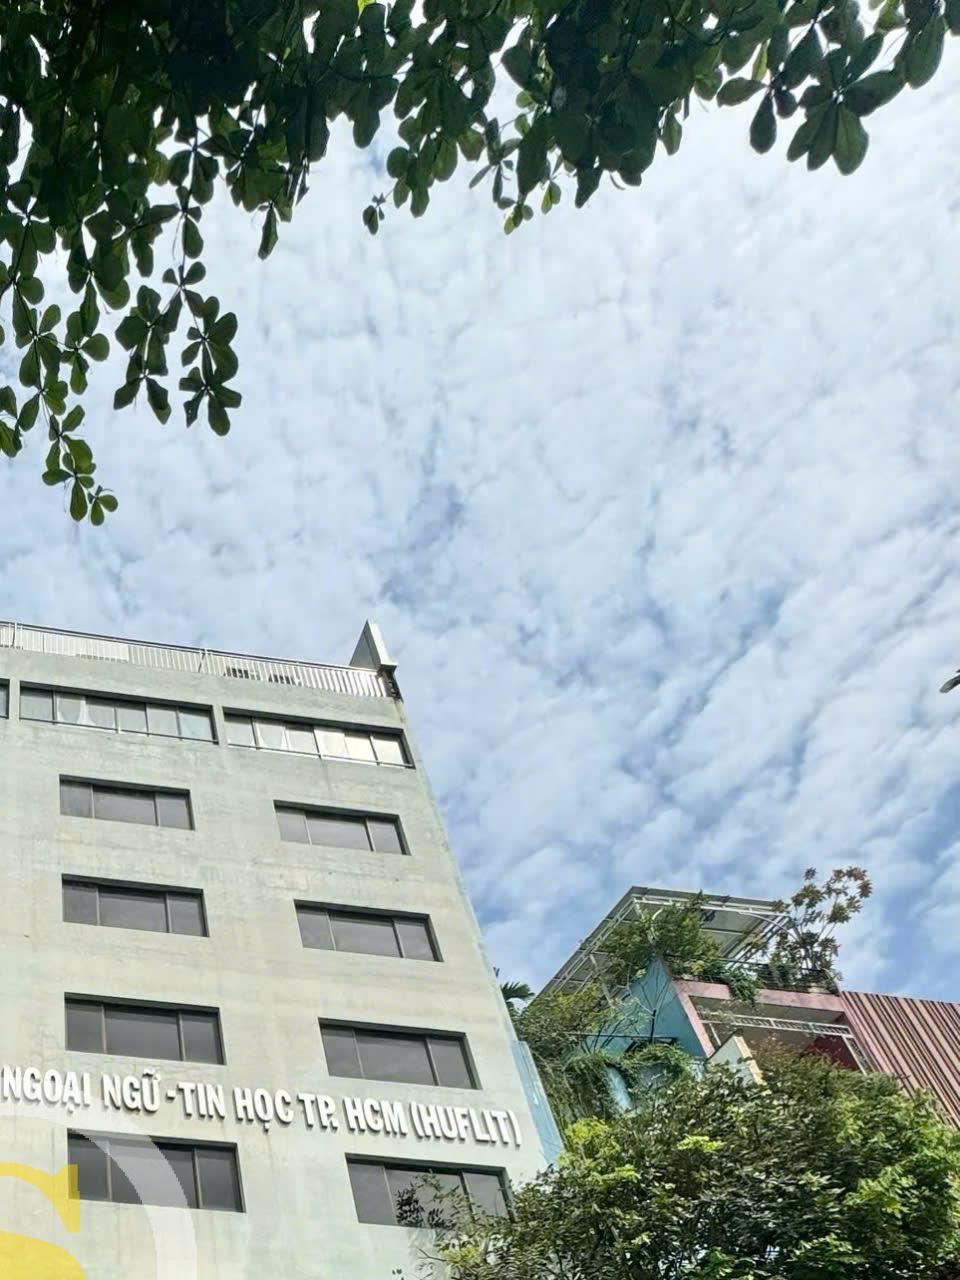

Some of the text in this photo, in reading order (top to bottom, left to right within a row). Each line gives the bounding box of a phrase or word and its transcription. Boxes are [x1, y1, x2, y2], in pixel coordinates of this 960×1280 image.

[1, 1065, 90, 1113] NGOẠI
[102, 1068, 161, 1113] NGỮ
[233, 1087, 294, 1133] HỌC
[342, 1096, 407, 1136] HCM
[409, 1100, 522, 1147] (HUFLIT)
